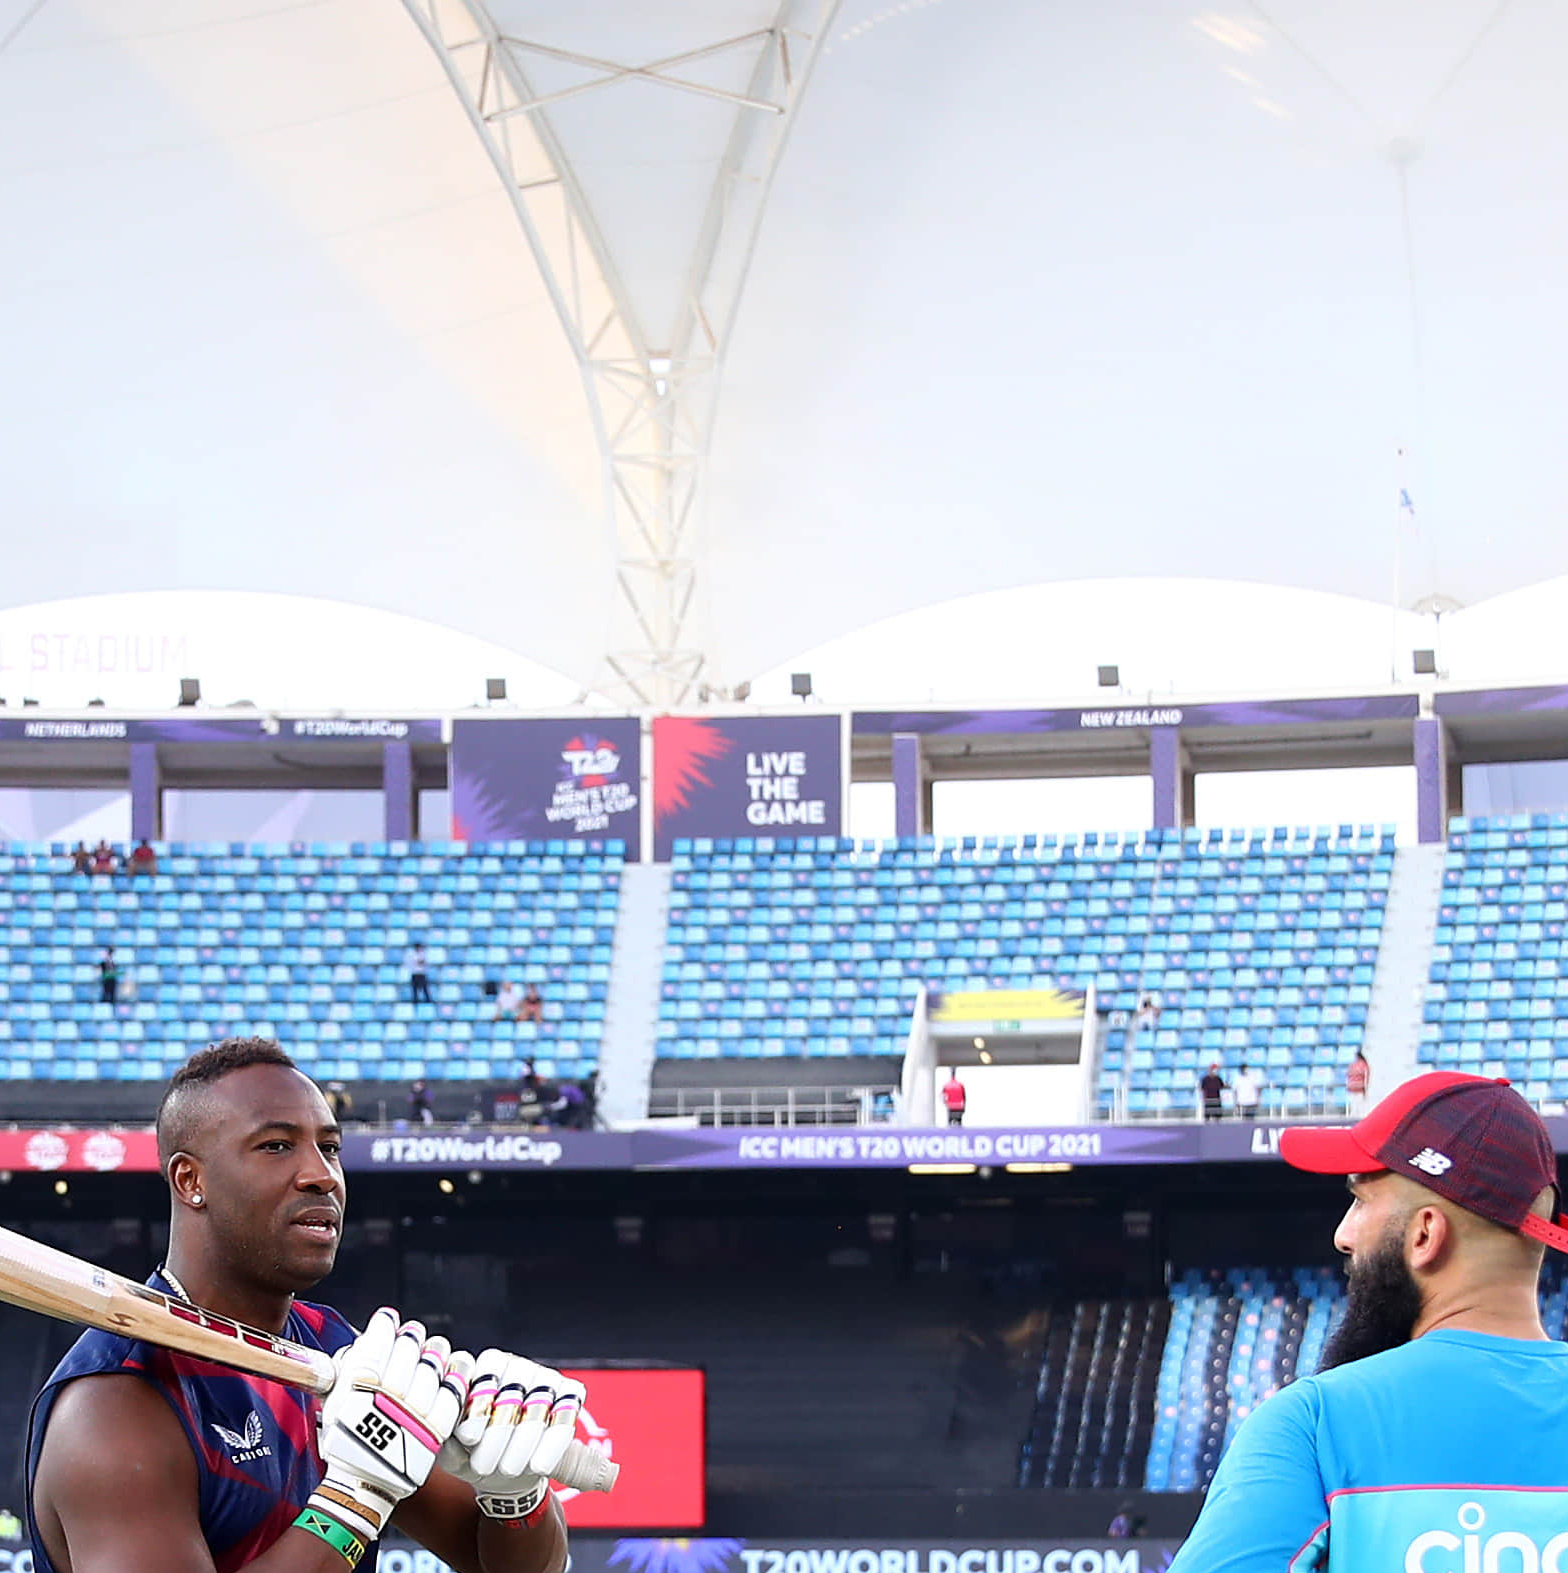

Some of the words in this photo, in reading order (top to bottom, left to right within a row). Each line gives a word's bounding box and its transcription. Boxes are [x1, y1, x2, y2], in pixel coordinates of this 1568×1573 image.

[31, 633, 190, 673] STADIUM
[25, 721, 127, 739] NETHERLANDS
[294, 719, 408, 739] #T20WorldCup
[1080, 711, 1115, 728] NEW
[1115, 708, 1183, 727] ZEALAND
[746, 752, 806, 777] LIVE
[746, 776, 799, 801] THE
[746, 801, 826, 825] GAME
[371, 1136, 562, 1165] #T20WorldCup
[739, 1135, 781, 1159] ICC
[782, 1135, 855, 1159] MEN'S
[857, 1136, 898, 1159] T20
[902, 1135, 991, 1159] WORLD
[996, 1135, 1046, 1158] CUP
[1048, 1133, 1102, 1157] 2021
[355, 1411, 397, 1451] SS
[491, 1490, 539, 1515] SS
